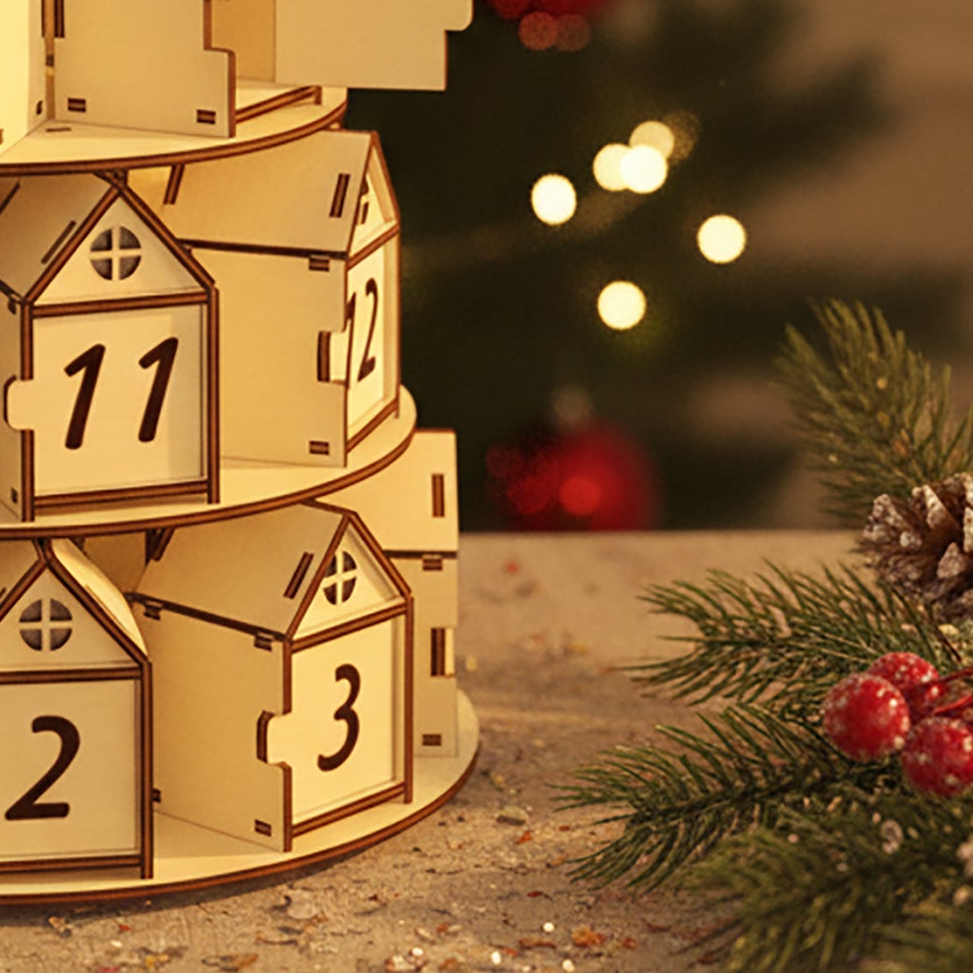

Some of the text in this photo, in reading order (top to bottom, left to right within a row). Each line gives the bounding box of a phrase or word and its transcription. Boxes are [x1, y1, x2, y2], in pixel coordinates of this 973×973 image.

[64, 337, 179, 450] 11
[4, 715, 81, 821] 2
[317, 664, 361, 772] 3
